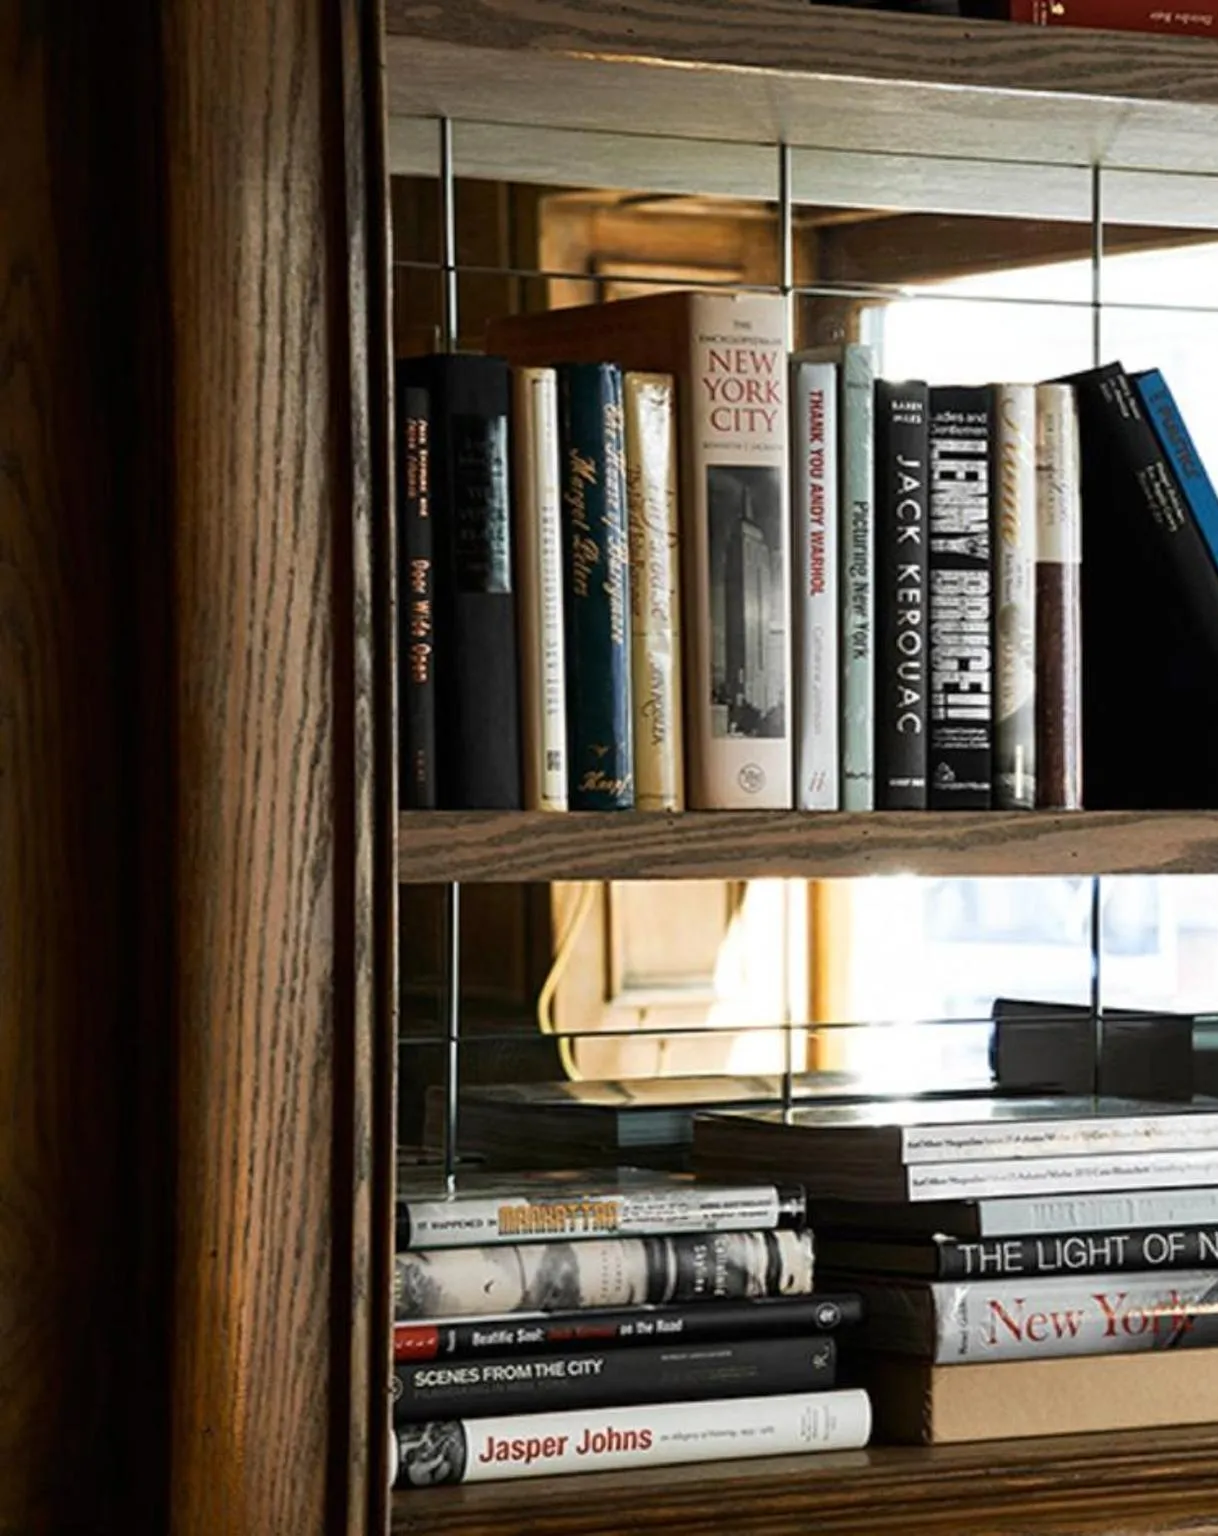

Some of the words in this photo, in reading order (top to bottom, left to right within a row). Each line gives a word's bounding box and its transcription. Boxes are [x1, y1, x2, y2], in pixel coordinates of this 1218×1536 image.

[709, 349, 778, 375] NEW
[703, 376, 782, 404] YORK
[709, 406, 778, 433] CITY
[808, 389, 825, 443] THANK
[808, 447, 825, 478] YOU
[809, 482, 825, 527] ANDY
[896, 454, 921, 544] JACK
[930, 439, 990, 560] LENNY
[850, 500, 870, 577] Picturing
[411, 559, 430, 594] Door
[809, 530, 826, 597] WARHOL
[412, 599, 431, 637] Wide
[851, 582, 870, 617] New
[851, 622, 870, 660] York
[896, 564, 921, 734] KEROUAC
[410, 643, 432, 682] Open
[497, 1201, 620, 1237] MANHATTAN
[957, 1241, 1023, 1274] THE
[1036, 1234, 1130, 1270] LIGHT
[1142, 1231, 1186, 1264] OF
[471, 1330, 514, 1347] Beatific
[635, 1320, 653, 1334] the
[655, 1318, 683, 1333] Road
[986, 1296, 1086, 1345] New
[1090, 1288, 1196, 1339] York
[415, 1367, 480, 1387] SCENES
[482, 1363, 532, 1383] FROM
[535, 1360, 566, 1379] THE
[567, 1358, 603, 1375] CITY
[479, 1435, 569, 1464] Jasper
[576, 1426, 653, 1455] Johns
